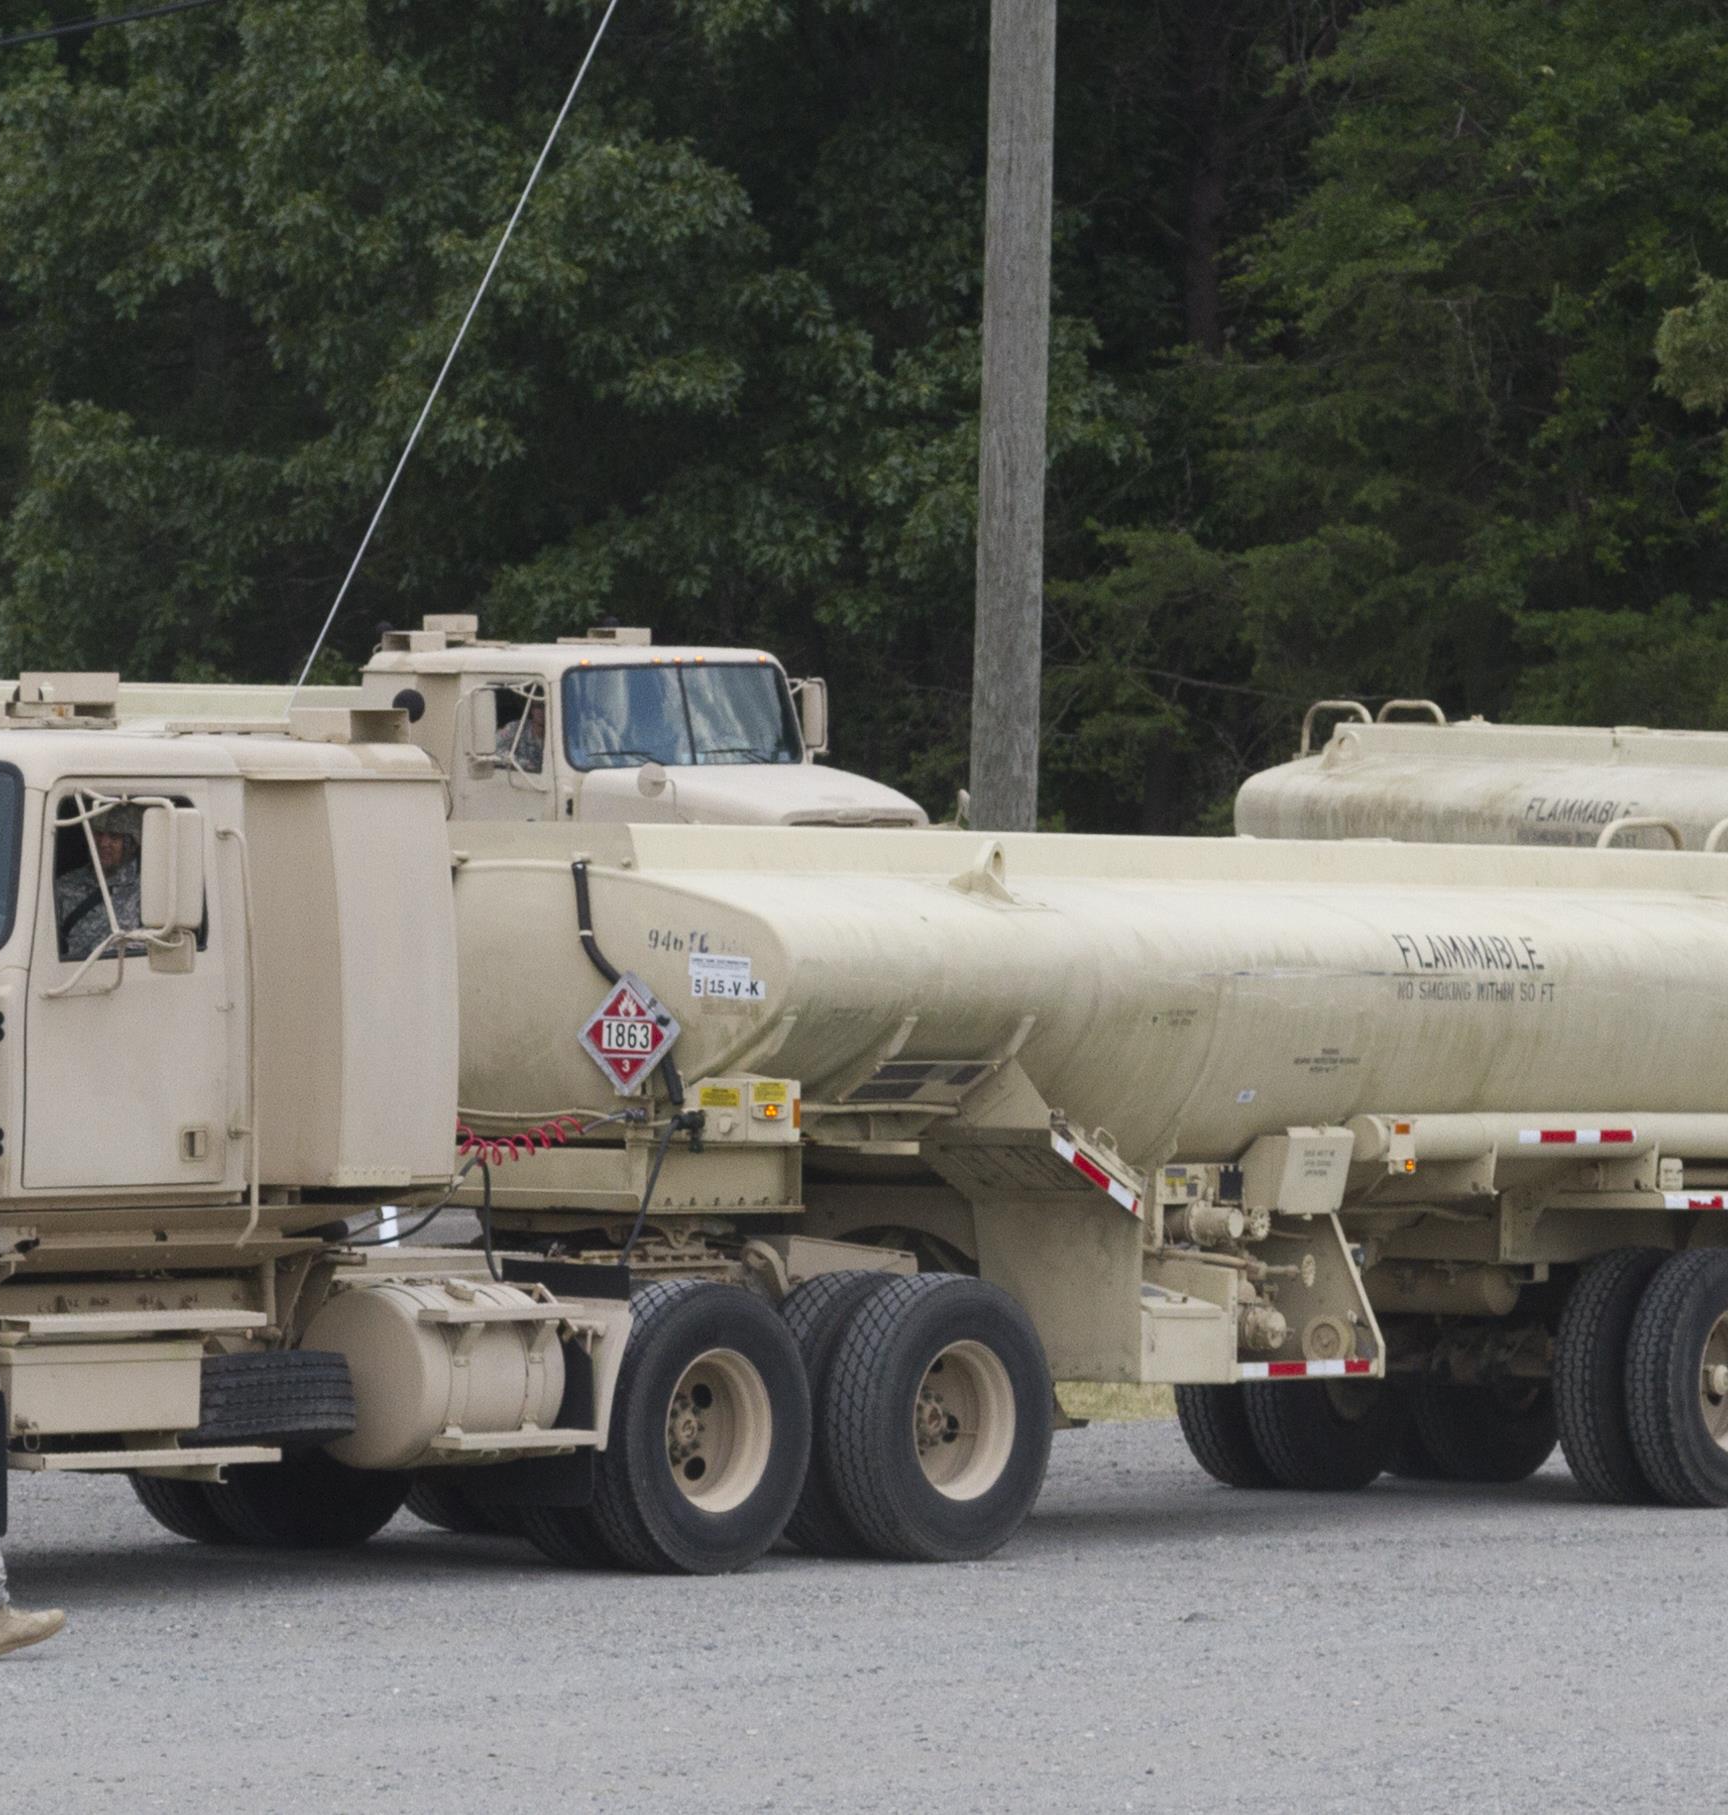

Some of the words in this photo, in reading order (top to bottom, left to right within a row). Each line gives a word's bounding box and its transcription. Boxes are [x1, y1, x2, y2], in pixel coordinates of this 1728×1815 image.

[1391, 934, 1545, 969] FLAMMABLE
[1397, 981, 1414, 1001] NO
[1419, 981, 1472, 1001] SMOKING
[1476, 982, 1515, 1002] WITHIN
[1520, 982, 1536, 1002] 50
[1541, 983, 1555, 1003] FT
[605, 1023, 650, 1049] 1863
[621, 1059, 631, 1073] 3
